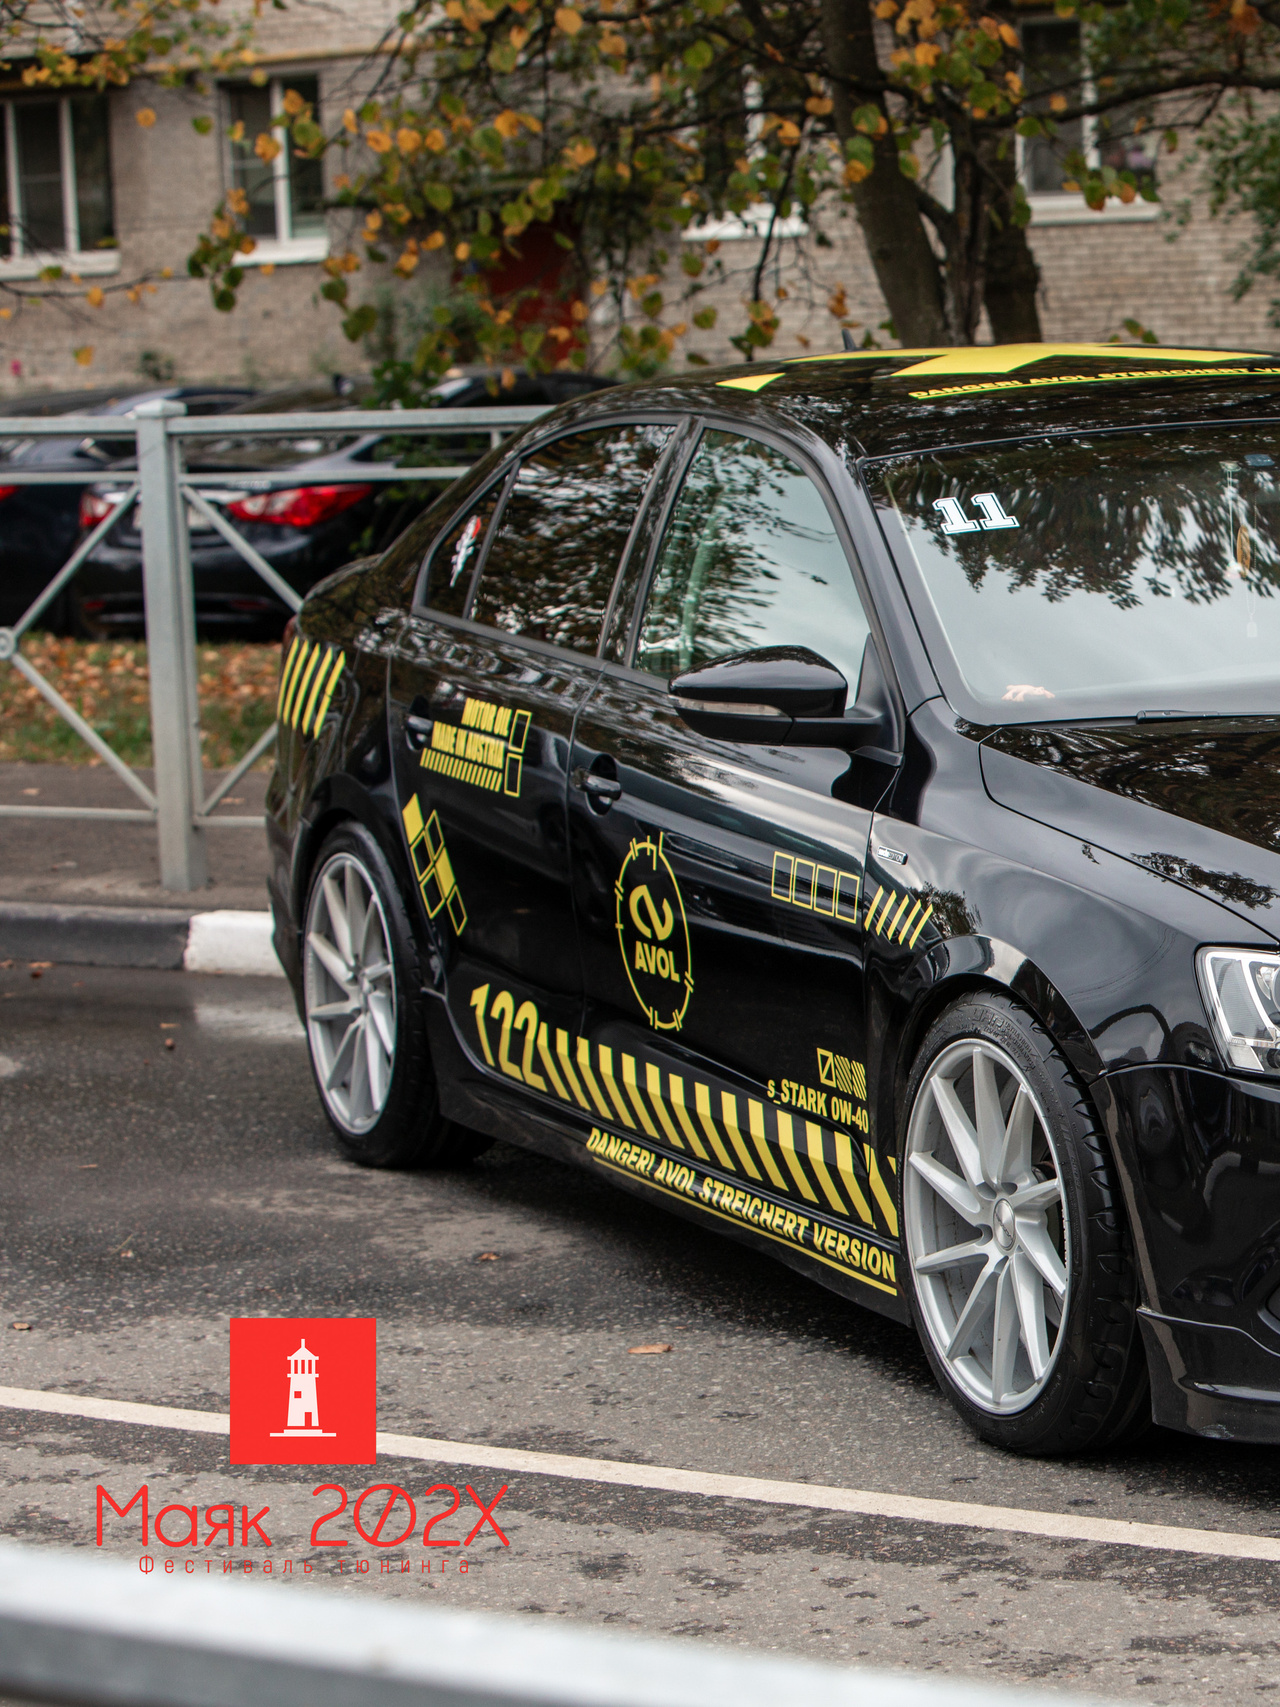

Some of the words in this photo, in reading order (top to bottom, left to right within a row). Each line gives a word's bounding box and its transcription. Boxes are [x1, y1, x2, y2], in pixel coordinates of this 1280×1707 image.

[931, 492, 1020, 534] 11
[461, 697, 498, 733] MOTOR
[493, 706, 513, 737] OIL
[431, 720, 458, 755] MADE
[455, 728, 468, 758] IN
[465, 731, 505, 770] AUSTRIA
[635, 940, 680, 983] AVOL
[469, 983, 549, 1094] 122
[585, 1127, 656, 1176] DANGER!
[653, 1158, 697, 1198] AVOL
[698, 1177, 811, 1244] STREICHERT
[812, 1222, 897, 1283] VERSION
